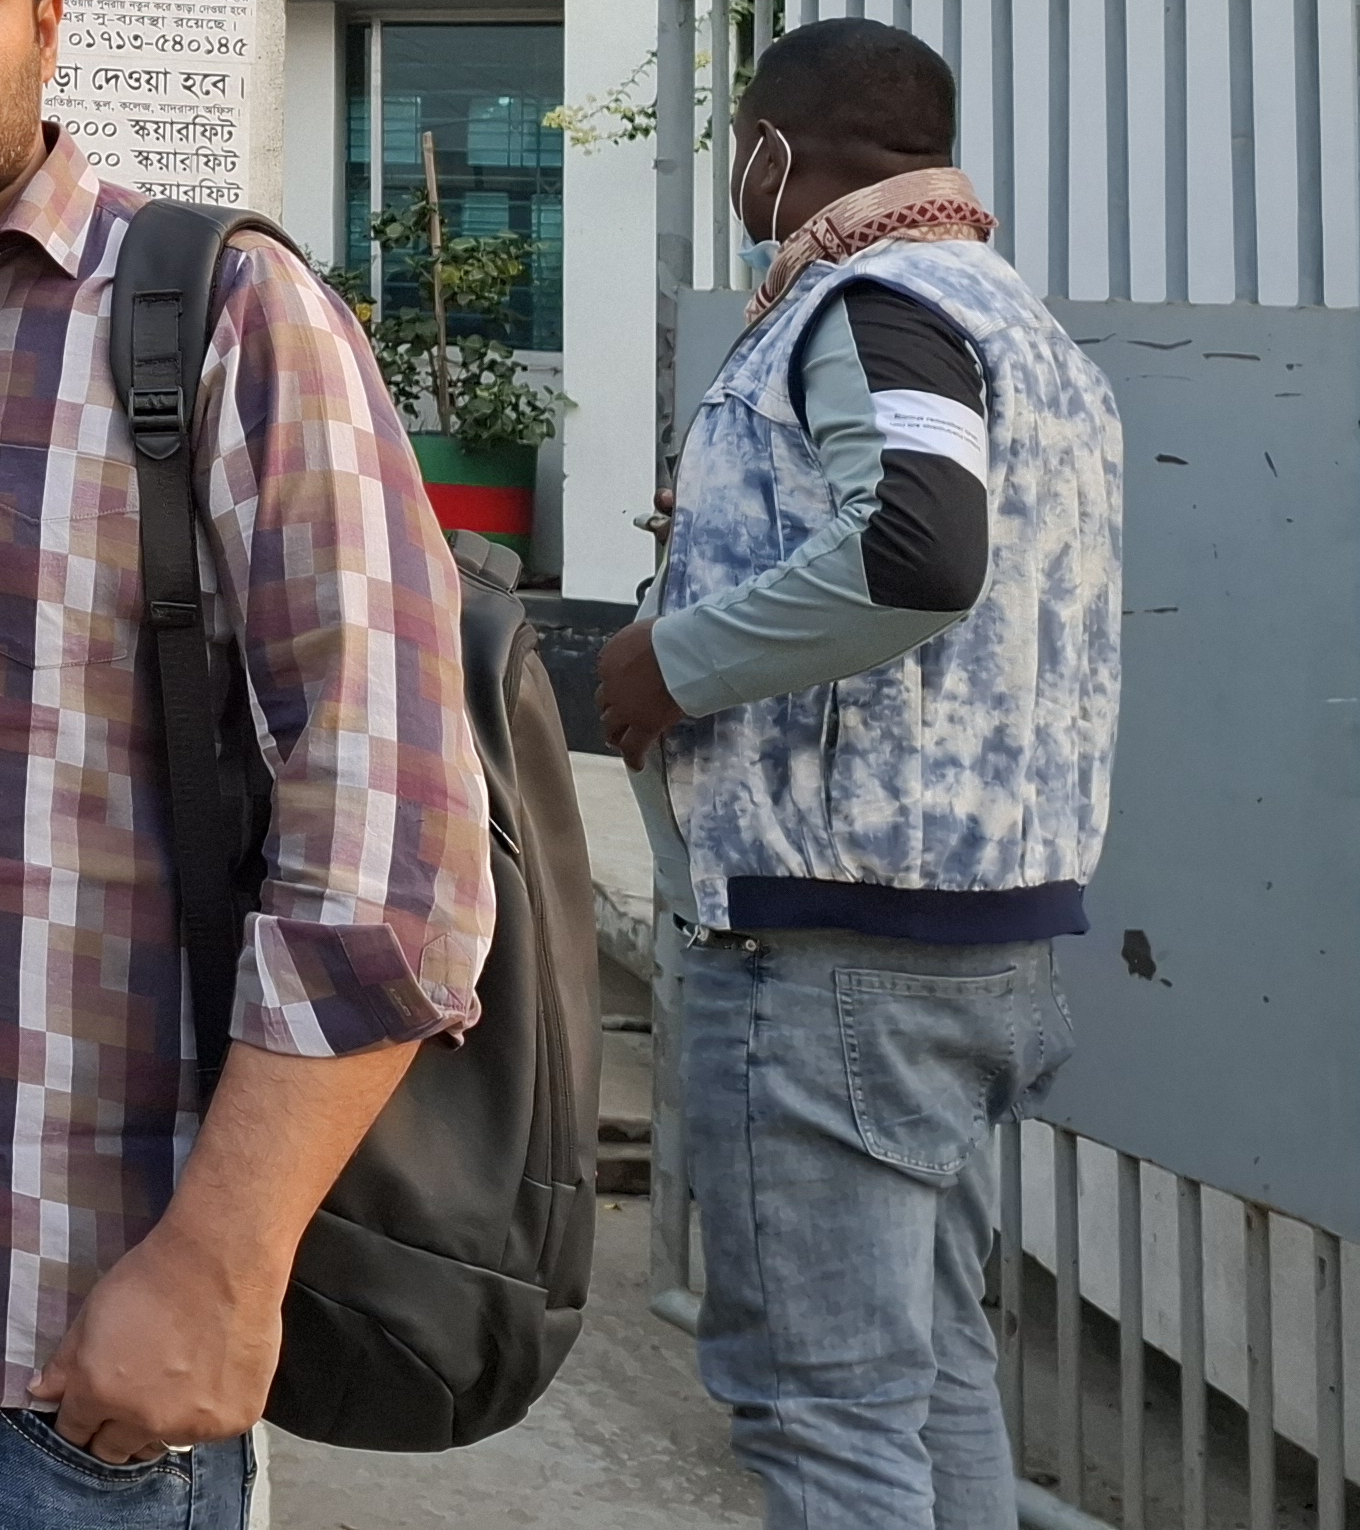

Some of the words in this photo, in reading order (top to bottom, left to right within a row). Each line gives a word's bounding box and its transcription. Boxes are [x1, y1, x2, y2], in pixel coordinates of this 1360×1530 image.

[130, 0, 150, 12] নতুন
[153, 1, 172, 12] করে
[199, 4, 226, 15] দেওয়া
[68, 29, 249, 57] ০১৭১৩-৫৪০১৪৫
[92, 67, 172, 95] দেওয়া
[127, 115, 237, 145] স্কয়ারফিট
